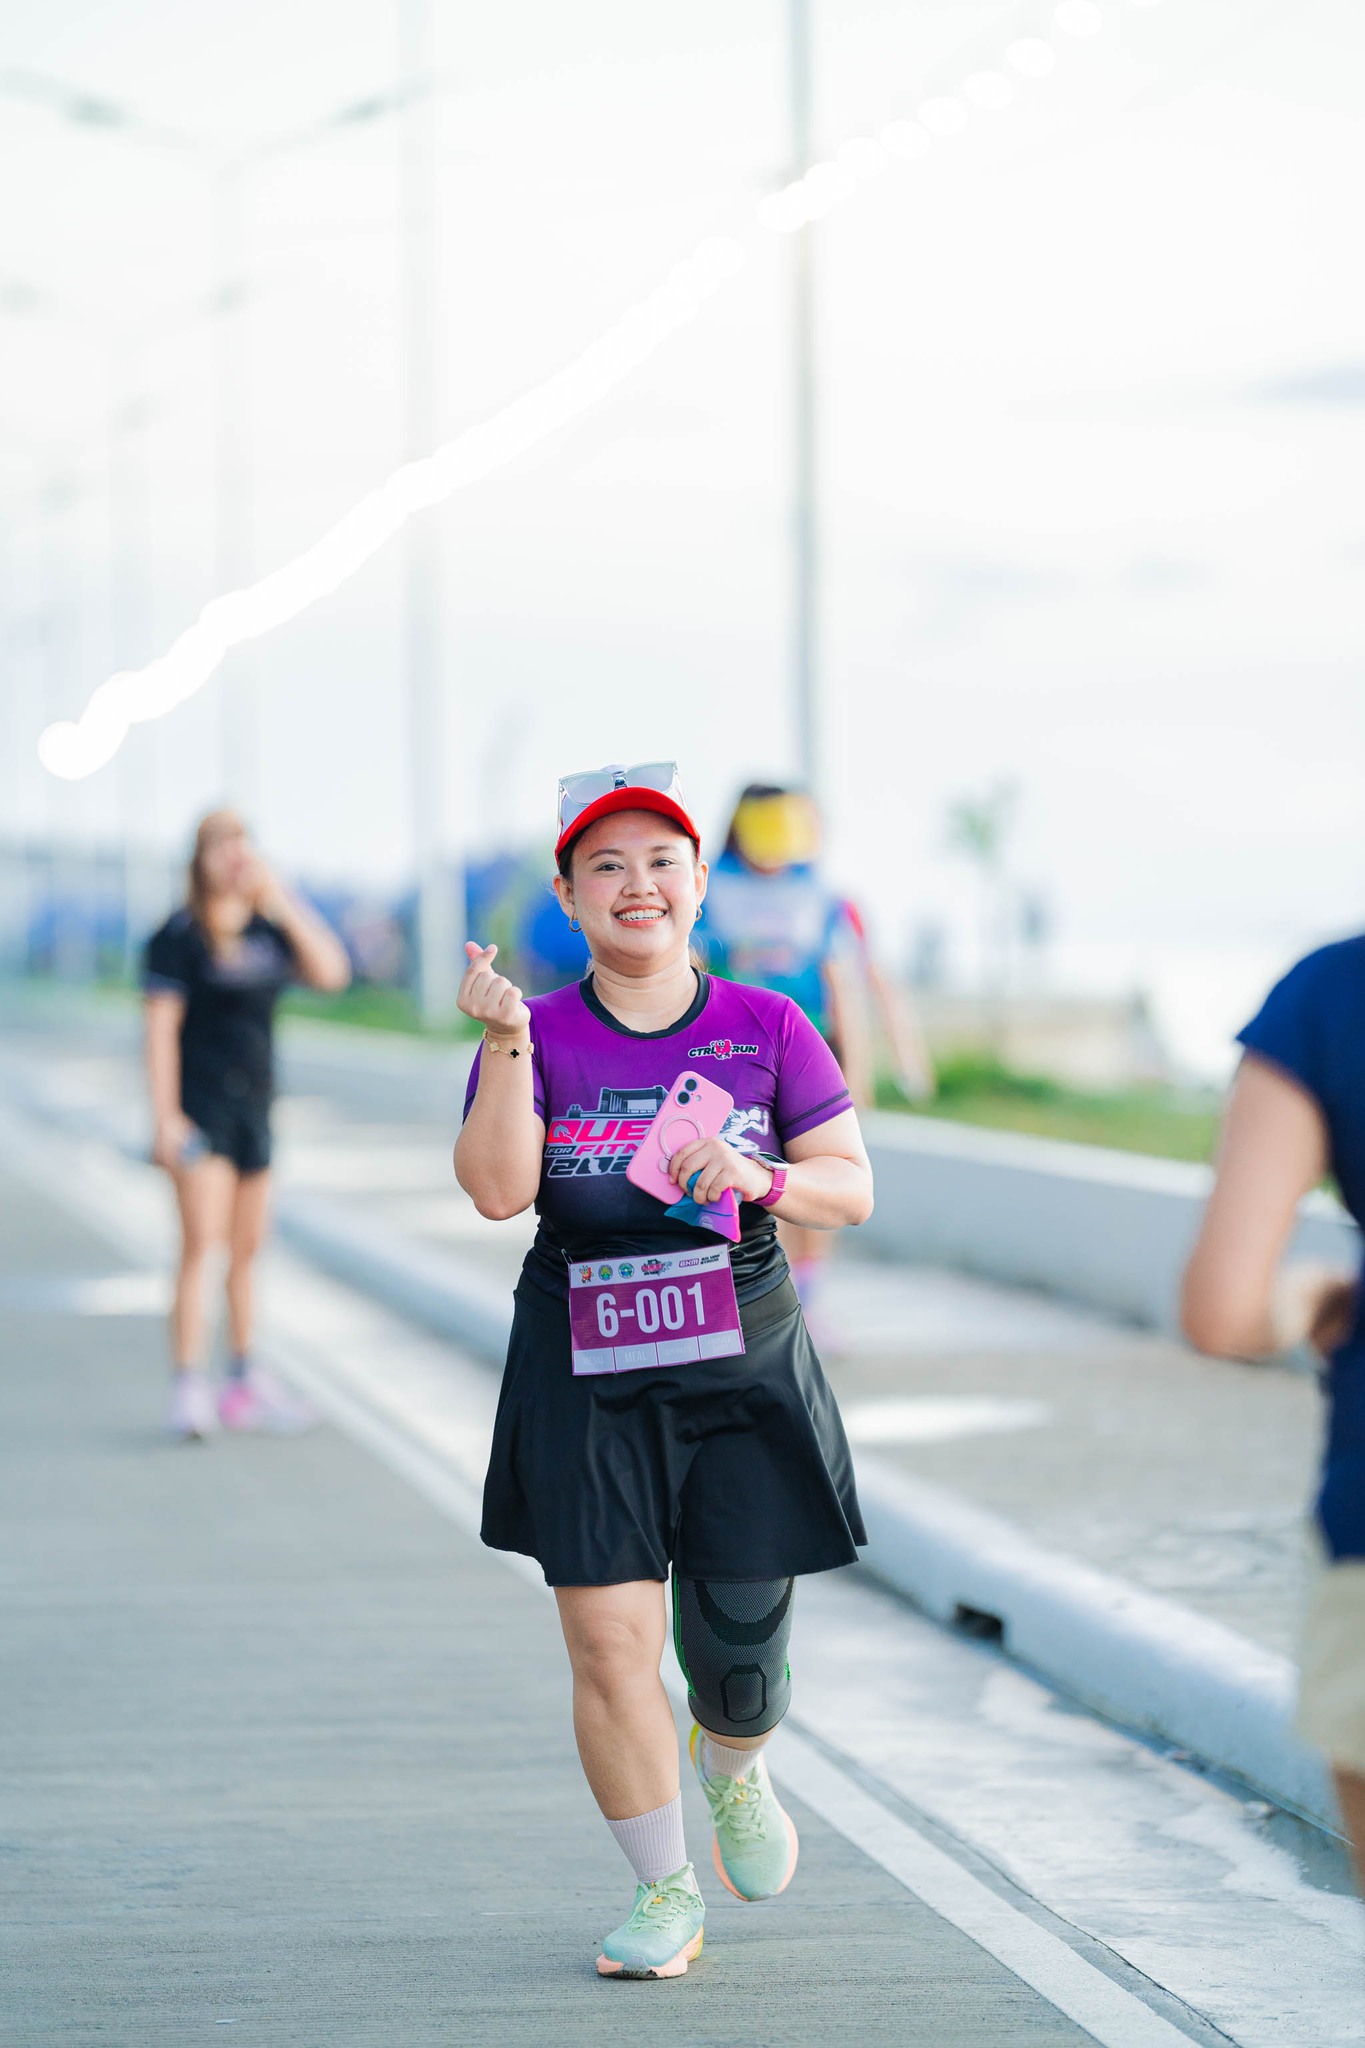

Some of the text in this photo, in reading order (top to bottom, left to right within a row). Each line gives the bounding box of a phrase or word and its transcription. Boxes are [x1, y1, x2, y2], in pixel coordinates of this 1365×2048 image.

[731, 1045, 757, 1054] RUN
[547, 1120, 653, 1143] QUE
[575, 1144, 640, 1156] FITN
[596, 1281, 706, 1338] 6-001
[625, 1350, 646, 1362] MEAL
